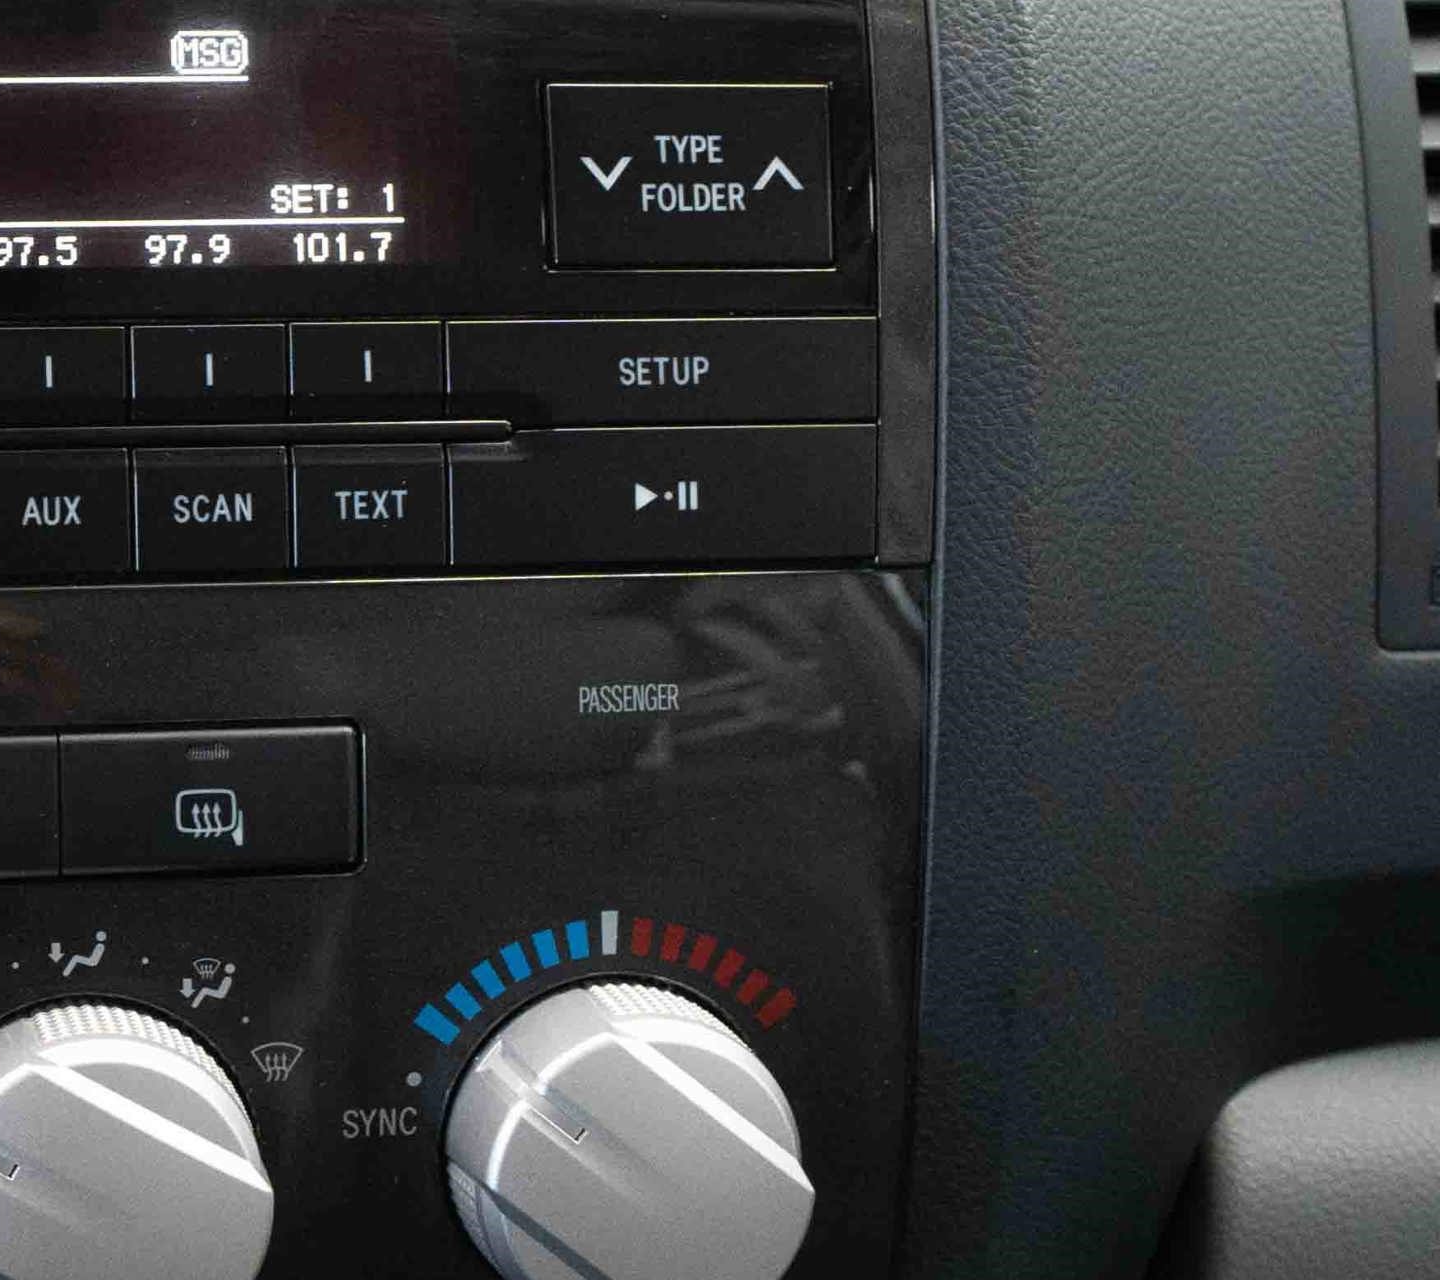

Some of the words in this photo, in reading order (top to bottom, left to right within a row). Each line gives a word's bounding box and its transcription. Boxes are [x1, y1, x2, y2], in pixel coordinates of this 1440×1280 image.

[177, 37, 242, 66] MSG
[654, 134, 724, 164] TYPE
[269, 183, 349, 215] SET:
[382, 183, 395, 213] 1
[641, 182, 746, 212] FOLDER
[144, 233, 231, 267] 97.9
[292, 231, 393, 263] 101.7
[618, 356, 710, 386] SETUP
[22, 495, 81, 526] AUX
[173, 492, 253, 524] SCAN
[334, 489, 408, 520] TEXT
[578, 683, 680, 713] PASSENGER
[342, 1106, 418, 1139] SYNC
